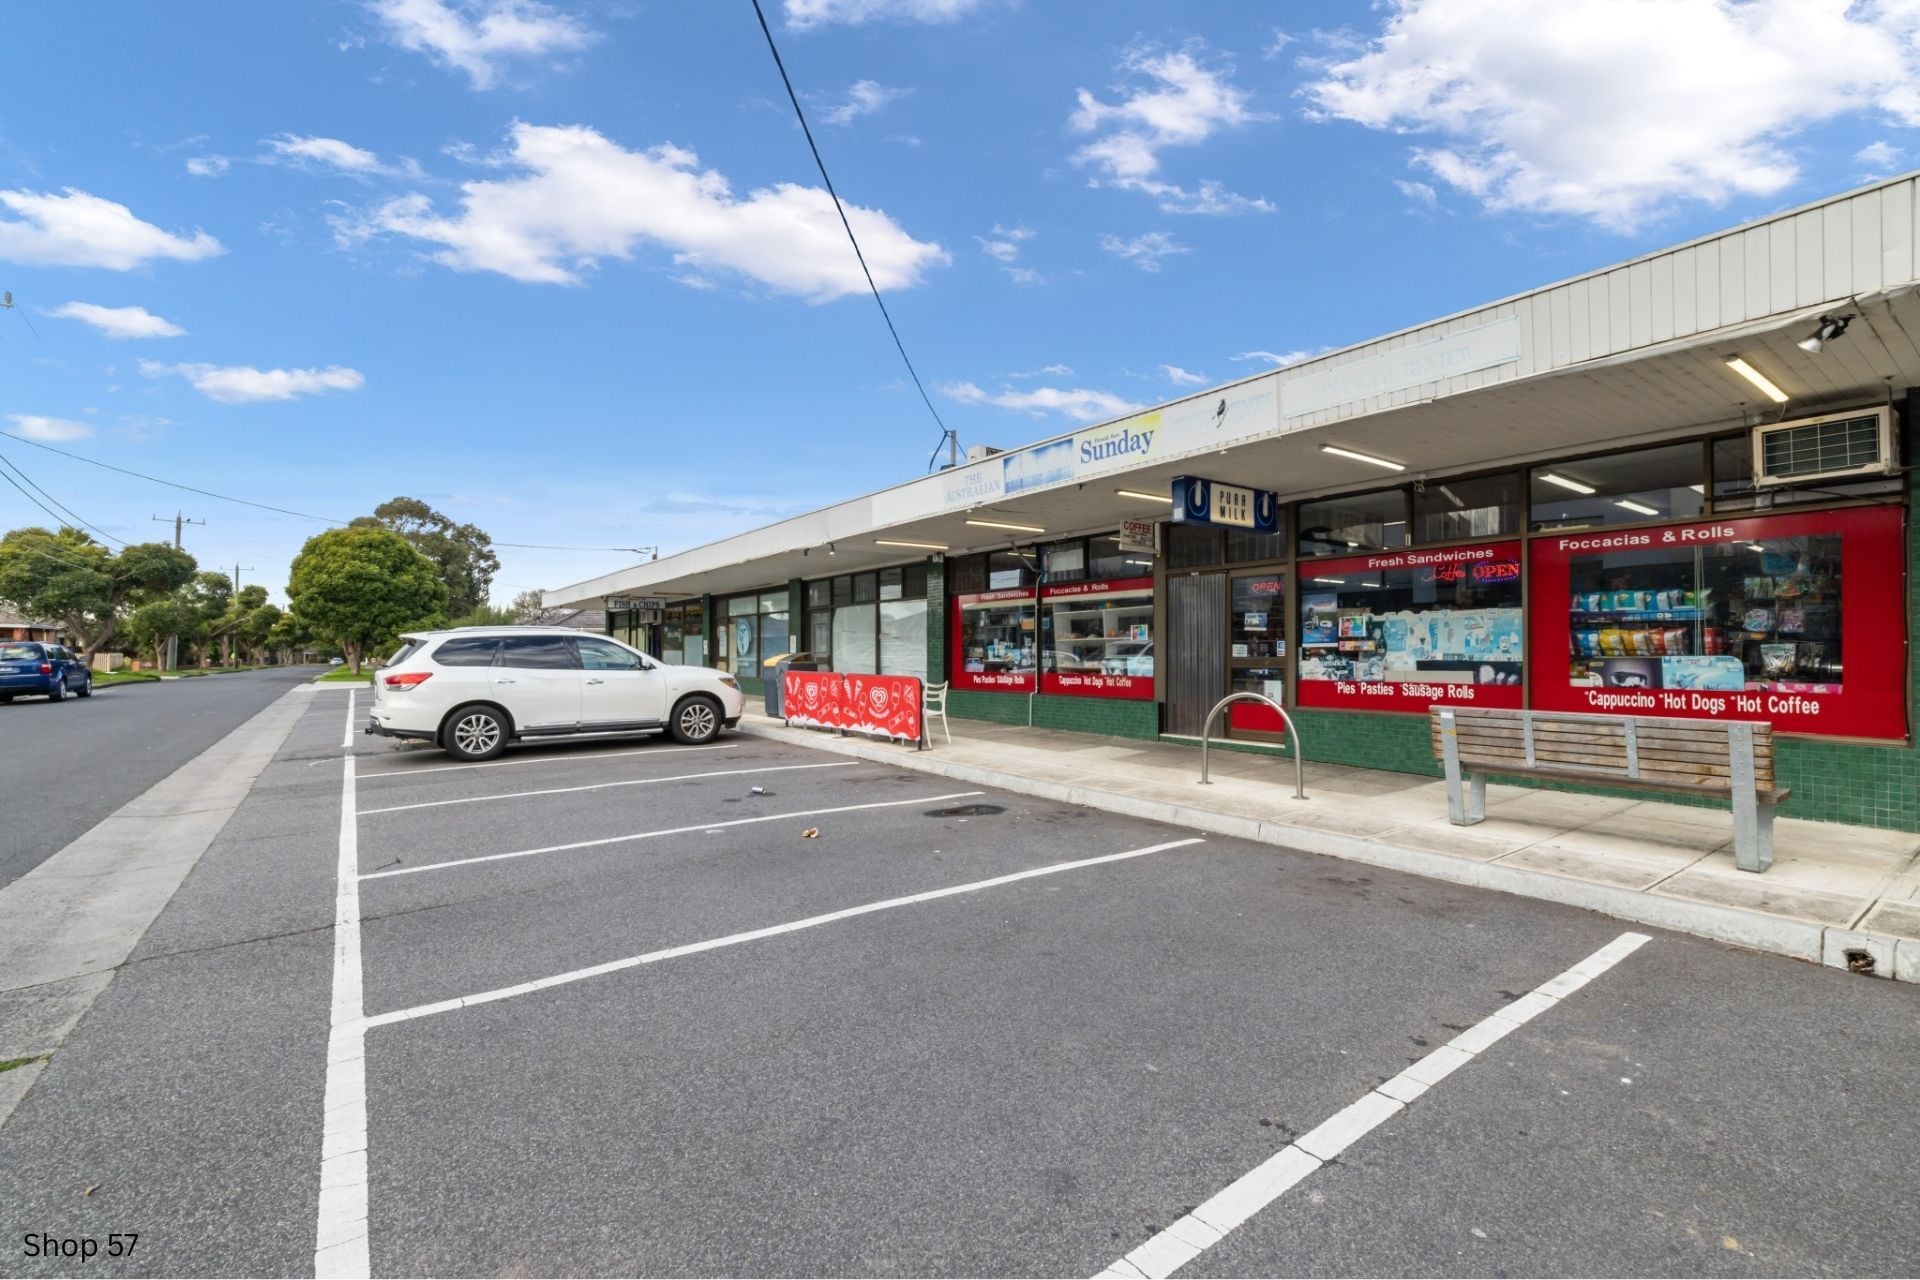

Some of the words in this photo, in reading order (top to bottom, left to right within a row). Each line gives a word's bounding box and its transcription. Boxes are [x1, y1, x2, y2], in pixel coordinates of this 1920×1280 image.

[1080, 429, 1154, 465] Sunday
[964, 472, 982, 487] THE
[1219, 490, 1246, 508] PURA
[1219, 505, 1246, 522] MILK
[1123, 520, 1152, 535] COFFEE
[1559, 534, 1650, 551] Foccacias
[1662, 530, 1676, 543] &
[1681, 526, 1736, 541] Rolls
[1368, 556, 1403, 568] Fresh
[1407, 549, 1494, 565] Sandwiches
[1472, 562, 1520, 580] OPEN
[997, 590, 1029, 600] Sandwiches
[1049, 587, 1081, 595] Foccacias
[1091, 583, 1109, 591] Rolls
[1251, 581, 1281, 593] OPEN
[614, 600, 630, 609] FISH
[639, 600, 660, 609] CHIPS
[1092, 676, 1103, 688] Dogs
[1116, 677, 1132, 688] Coffee
[1337, 682, 1356, 694] Pies
[1360, 682, 1394, 696] Pasties
[1401, 683, 1444, 701] Sausage
[1447, 684, 1475, 699] Rolls
[1588, 690, 1656, 710] Cappuccino
[1664, 692, 1687, 710] Hot
[1691, 693, 1726, 715] Dogs
[1737, 694, 1762, 713] Hot
[1768, 695, 1820, 715] Coffee
